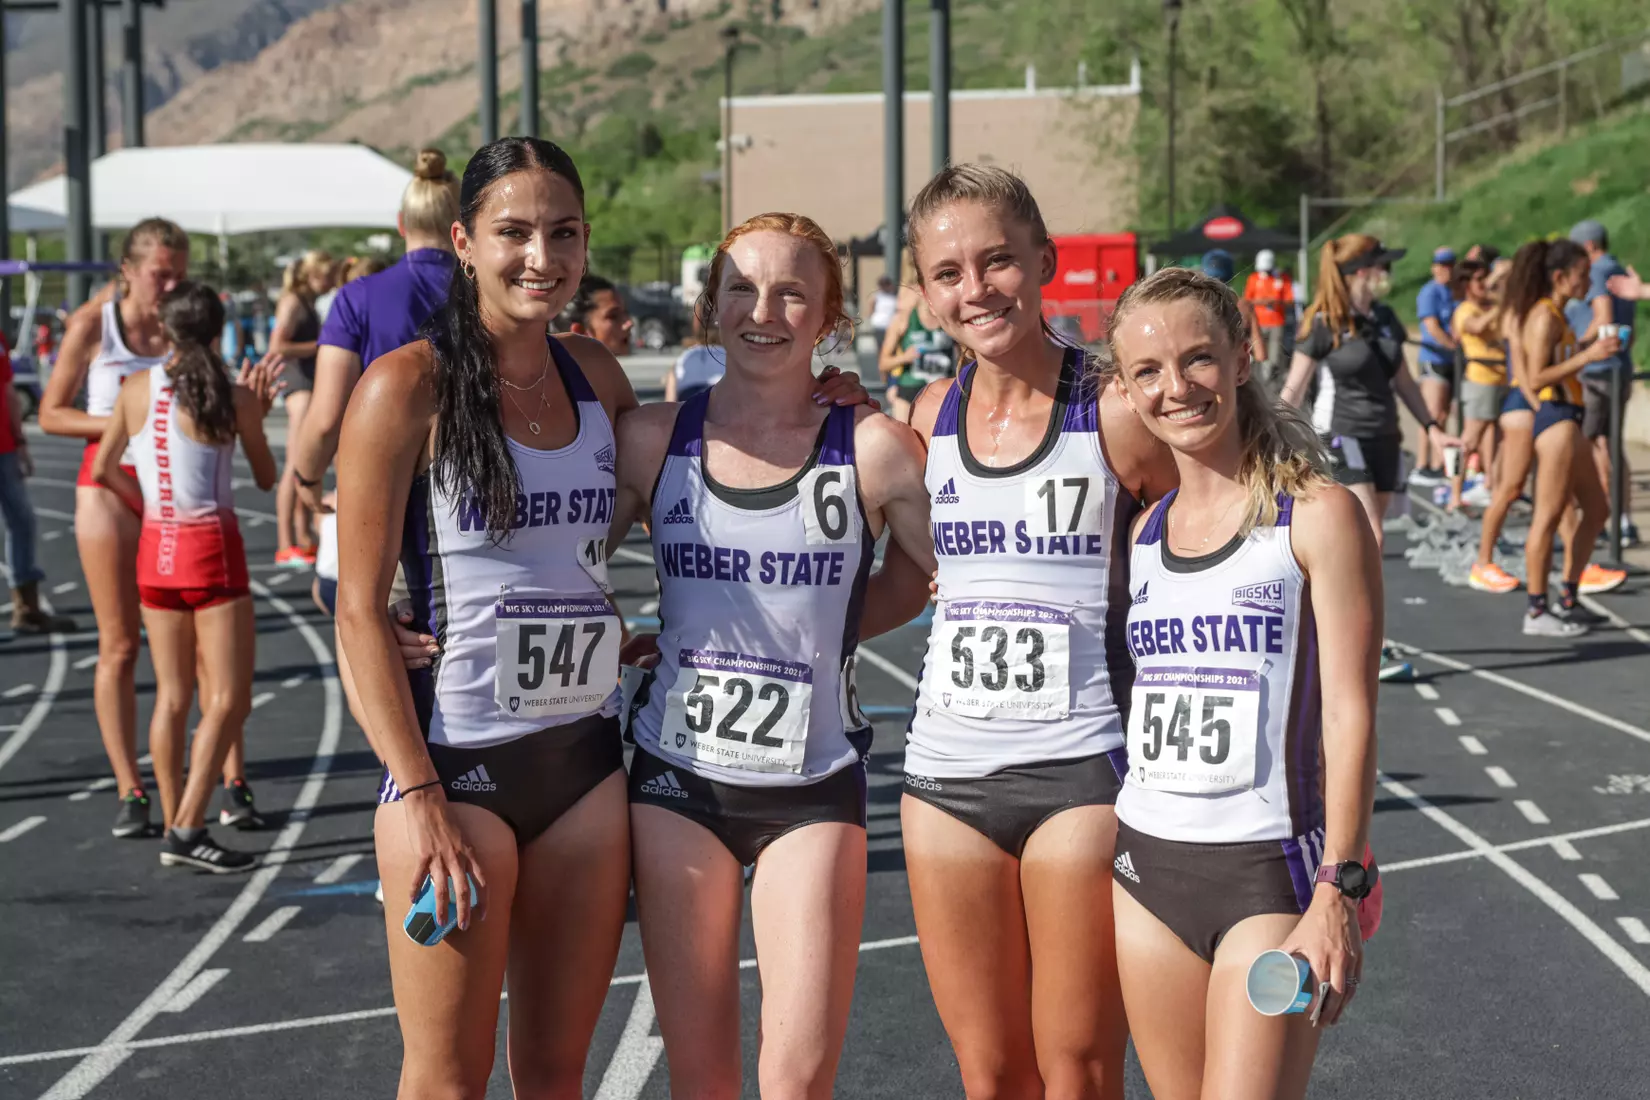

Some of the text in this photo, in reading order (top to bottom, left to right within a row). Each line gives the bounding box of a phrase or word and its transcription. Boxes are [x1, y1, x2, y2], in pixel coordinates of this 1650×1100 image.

[814, 471, 848, 540] 6
[935, 494, 960, 504] adidas
[1036, 477, 1089, 534] 17
[460, 491, 562, 532] WBER
[663, 514, 694, 524] adidas
[661, 543, 845, 585] WEBER STATE
[1235, 583, 1282, 600] BIGSKY
[505, 605, 520, 613] BIG
[521, 605, 535, 613] SKY
[1192, 615, 1283, 654] STATE
[517, 621, 606, 691] 547
[687, 655, 699, 663] BIG
[699, 655, 712, 664] SKY
[713, 656, 782, 673] CHAMPIONSHIPS
[951, 626, 1045, 693] 533
[1164, 673, 1224, 684] CHAMPIONSHIPS
[1226, 675, 1247, 685] 2021
[524, 693, 604, 707] WEBER STATE UNIVERSITY
[685, 675, 789, 748] 522
[1142, 693, 1234, 765] 545
[690, 740, 786, 766] WEBER STATE UNIVERSITY
[451, 779, 497, 791] adidas
[641, 782, 688, 799] adidas
[905, 775, 942, 791] adidas
[1114, 860, 1140, 883] adidas
